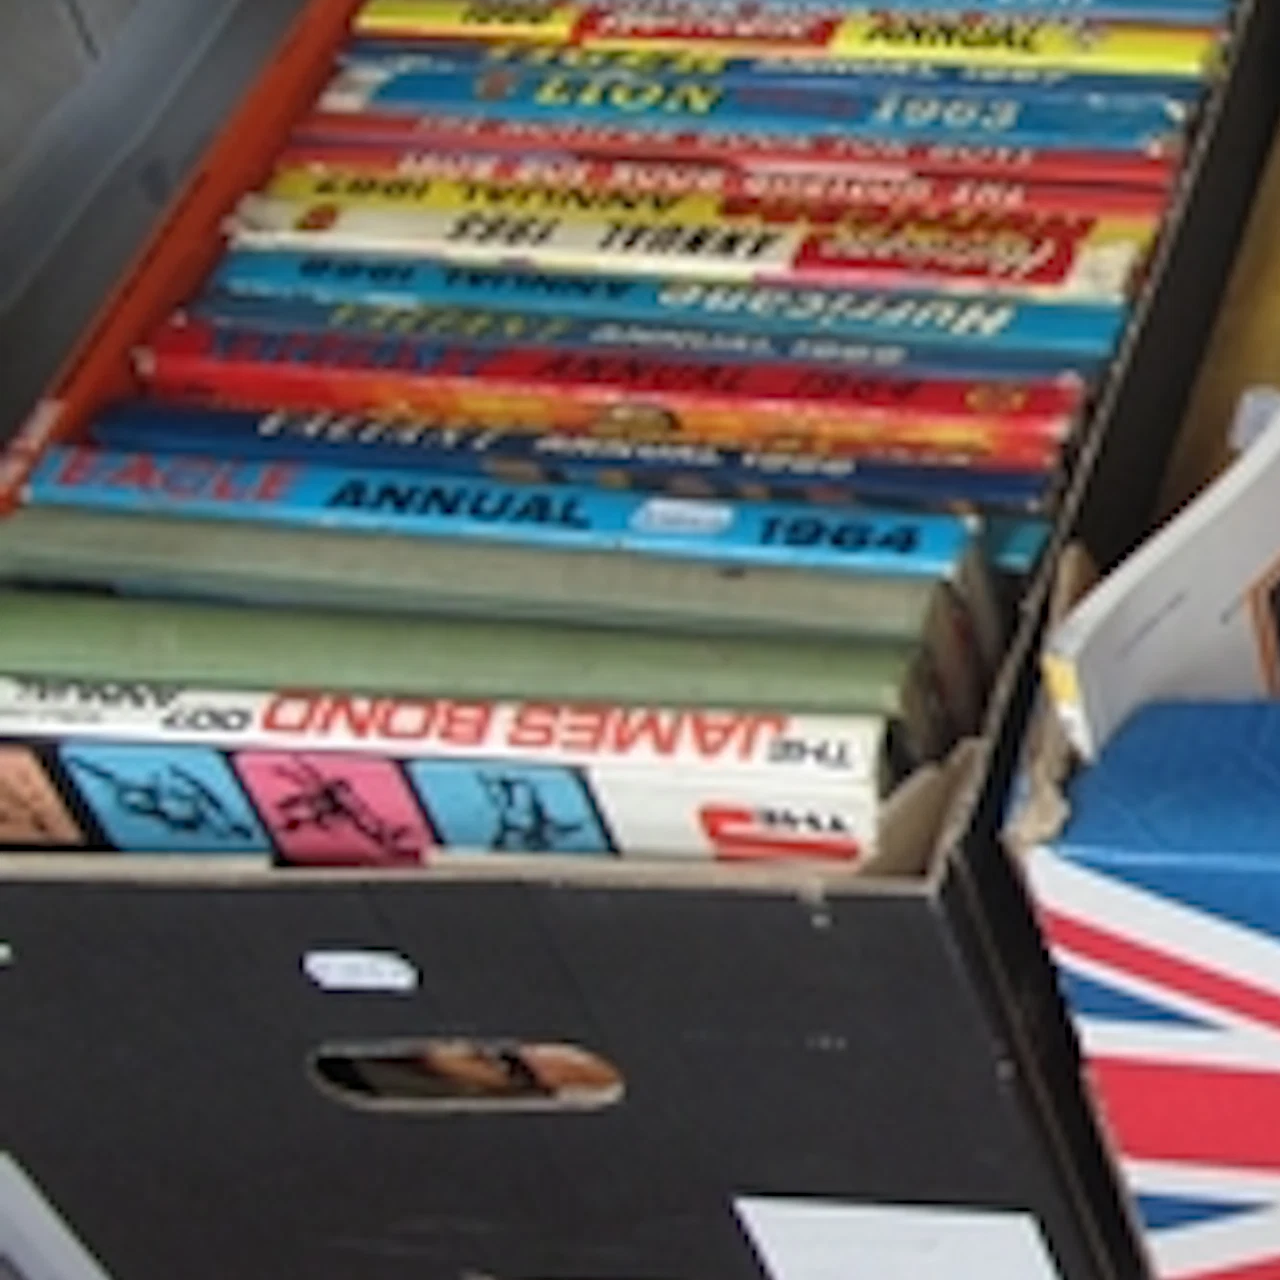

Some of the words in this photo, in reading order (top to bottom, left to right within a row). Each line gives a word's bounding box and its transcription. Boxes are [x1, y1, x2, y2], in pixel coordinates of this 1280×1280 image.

[535, 73, 724, 115] LION
[658, 281, 1018, 336] Hurricane
[45, 447, 298, 504] EAGLE
[323, 476, 595, 529] ANNUAL
[757, 516, 921, 554] 1964
[160, 706, 251, 733] 007
[261, 686, 492, 748] BOND
[508, 700, 791, 761] JAMES
[768, 737, 853, 769] THE
